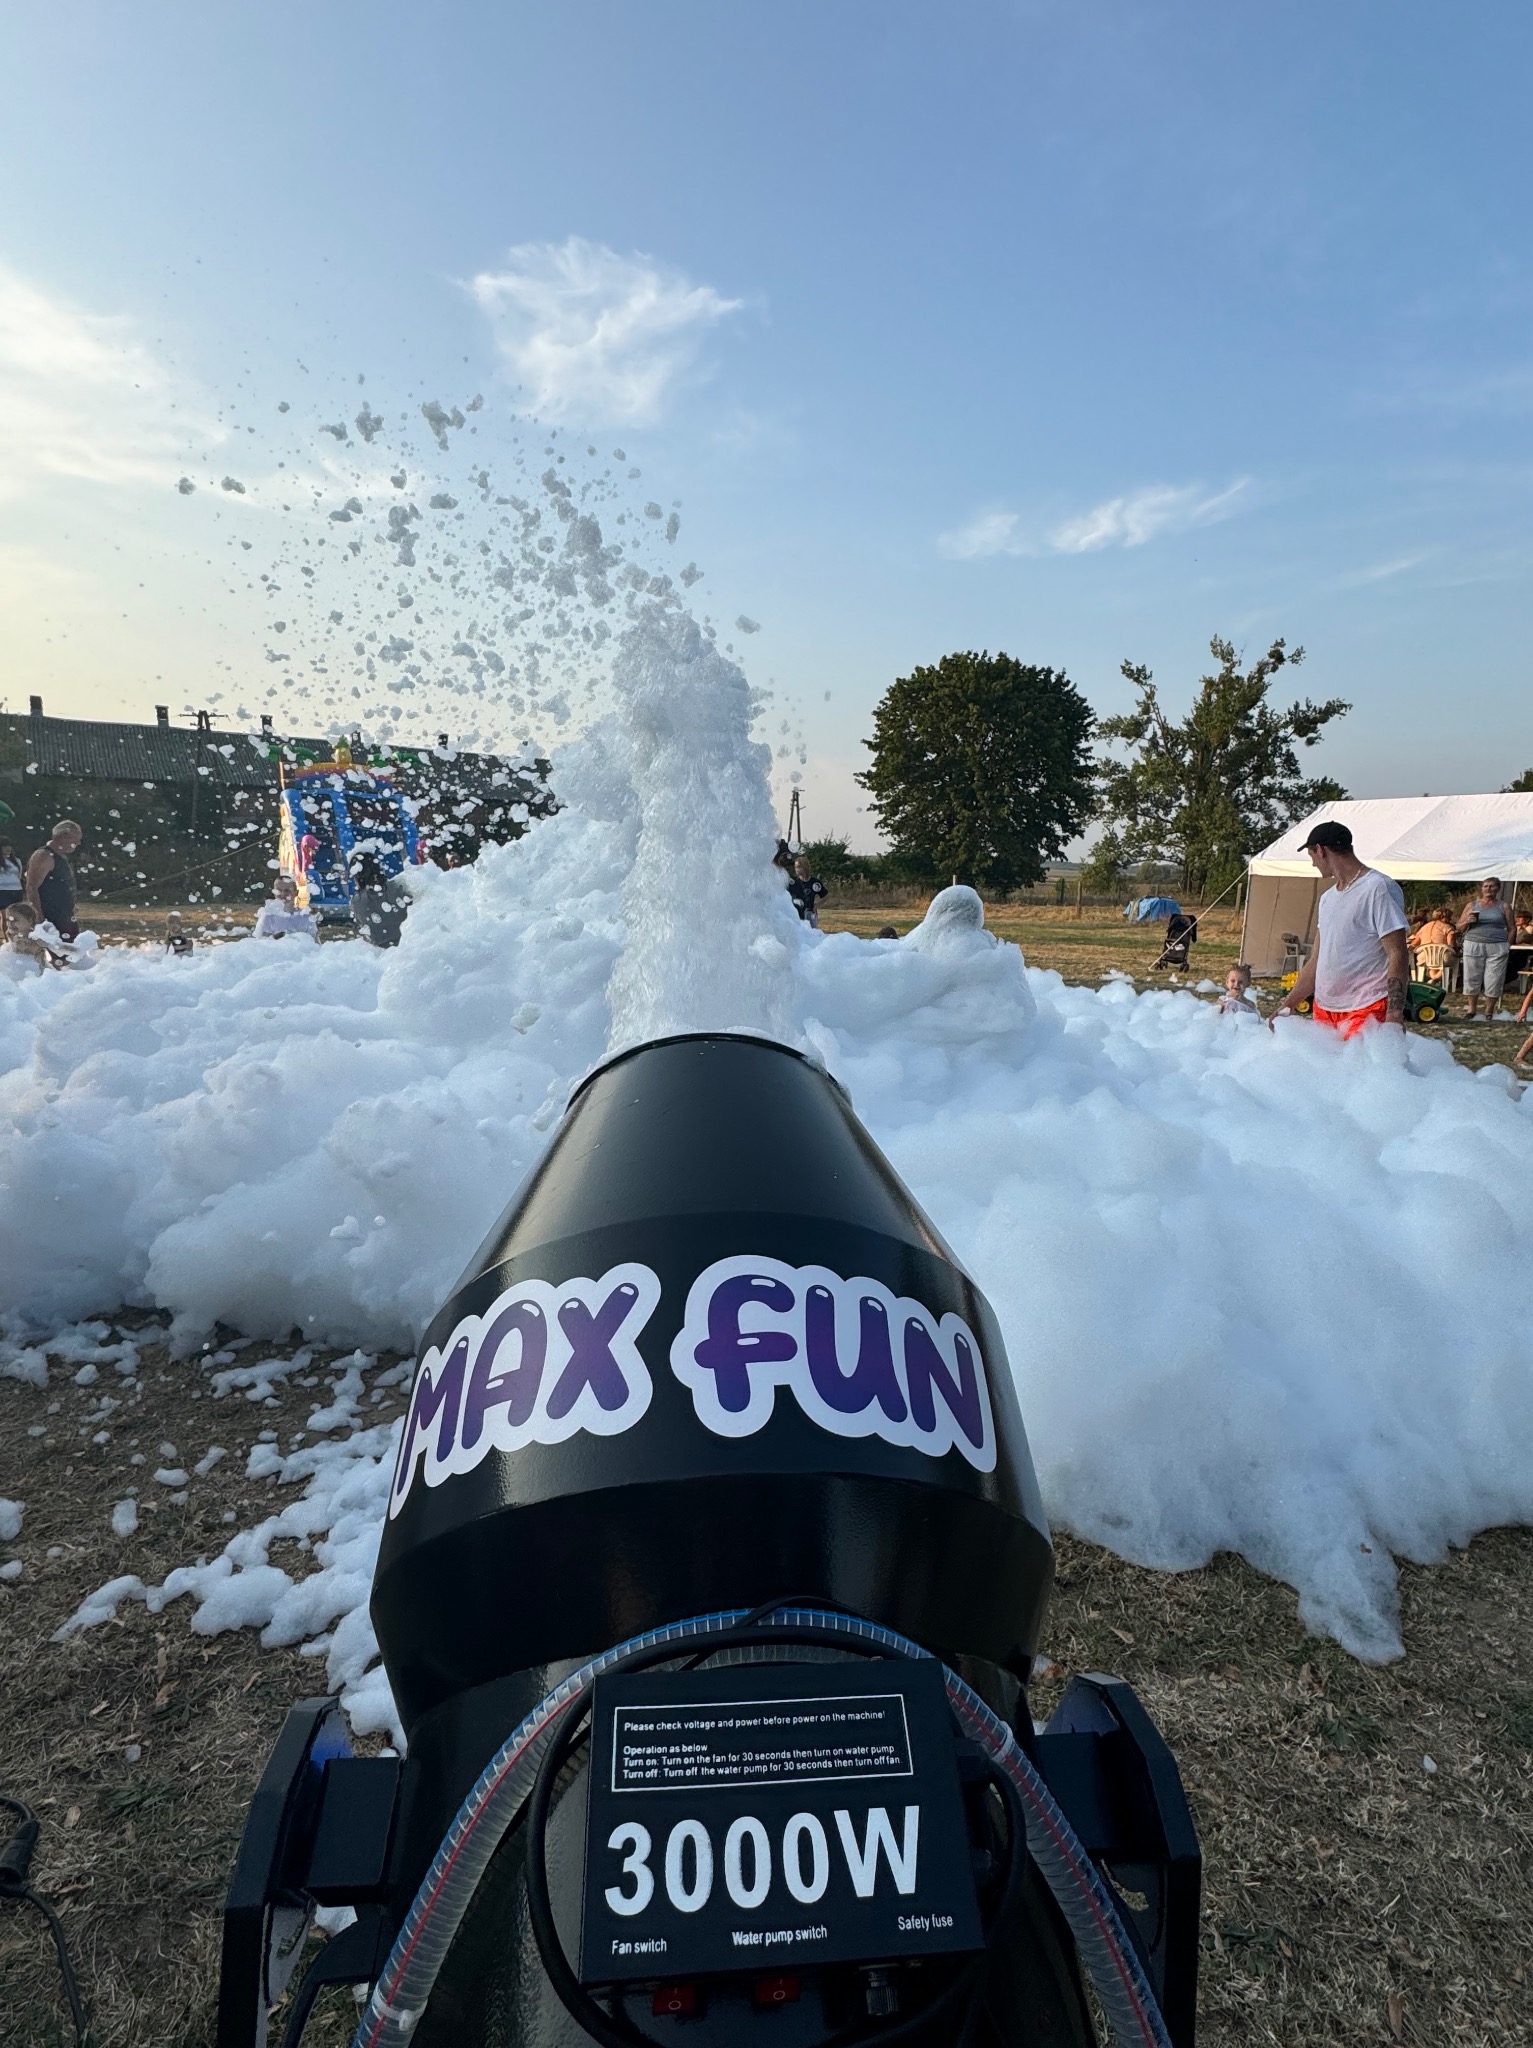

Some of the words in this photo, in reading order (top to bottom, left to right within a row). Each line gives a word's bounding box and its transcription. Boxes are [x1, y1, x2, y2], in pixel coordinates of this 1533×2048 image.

[395, 1279, 646, 1500] MAX
[690, 1270, 988, 1455] FUN
[624, 1722, 654, 1732] Please
[656, 1721, 682, 1730] check
[684, 1719, 716, 1731] voltage
[717, 1718, 734, 1728] and
[735, 1717, 761, 1728] power
[763, 1715, 791, 1725] before
[792, 1714, 818, 1725] power
[832, 1713, 846, 1722] the
[623, 1745, 668, 1757] Operation
[681, 1743, 708, 1753] below
[623, 1757, 644, 1767] Turn
[645, 1758, 659, 1766] on:
[661, 1756, 682, 1766] Turn
[683, 1756, 695, 1764] on
[696, 1754, 711, 1764] the
[712, 1754, 727, 1763] fan
[728, 1753, 740, 1762] for
[742, 1752, 754, 1761] 30
[754, 1749, 791, 1760] seconds
[793, 1749, 813, 1759] then
[813, 1748, 831, 1757] turn
[833, 1748, 844, 1756] on
[845, 1746, 869, 1755] water
[871, 1744, 895, 1754] pump
[623, 1769, 644, 1779] Turn
[663, 1767, 684, 1777] Turn
[685, 1767, 698, 1776] off
[701, 1766, 716, 1776] the
[717, 1765, 742, 1774] water
[743, 1764, 768, 1775] pump
[769, 1762, 782, 1772] for
[783, 1761, 795, 1771] 30
[796, 1760, 833, 1770] seconds
[834, 1759, 854, 1768] then
[855, 1758, 873, 1767] turn
[874, 1756, 886, 1765] off
[605, 1806, 920, 1917] 3000W
[897, 1916, 930, 1931] Safety
[931, 1913, 954, 1929] fuse
[731, 1929, 764, 1946] Water
[765, 1930, 794, 1945] pump
[795, 1924, 828, 1941] switch
[611, 1939, 632, 1955] Fan
[634, 1938, 668, 1953] switch
